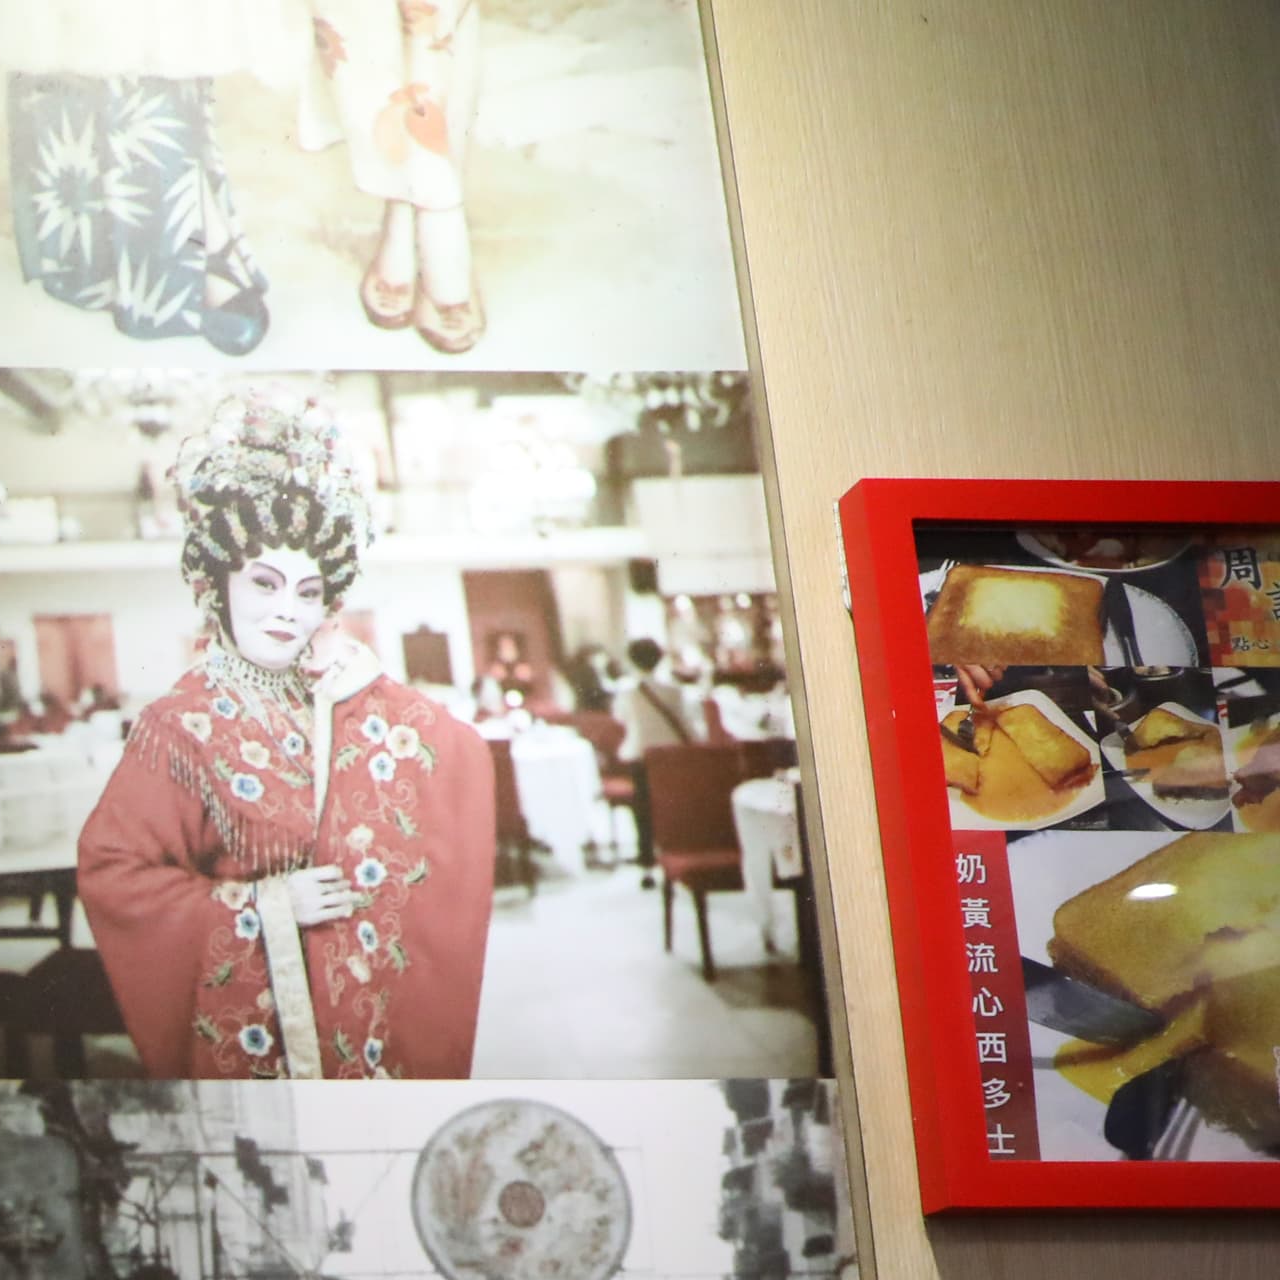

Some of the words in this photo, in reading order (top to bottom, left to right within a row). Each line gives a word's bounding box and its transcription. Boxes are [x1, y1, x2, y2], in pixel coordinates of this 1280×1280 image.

[955, 853, 1015, 1154] 奶黃流心西多士
